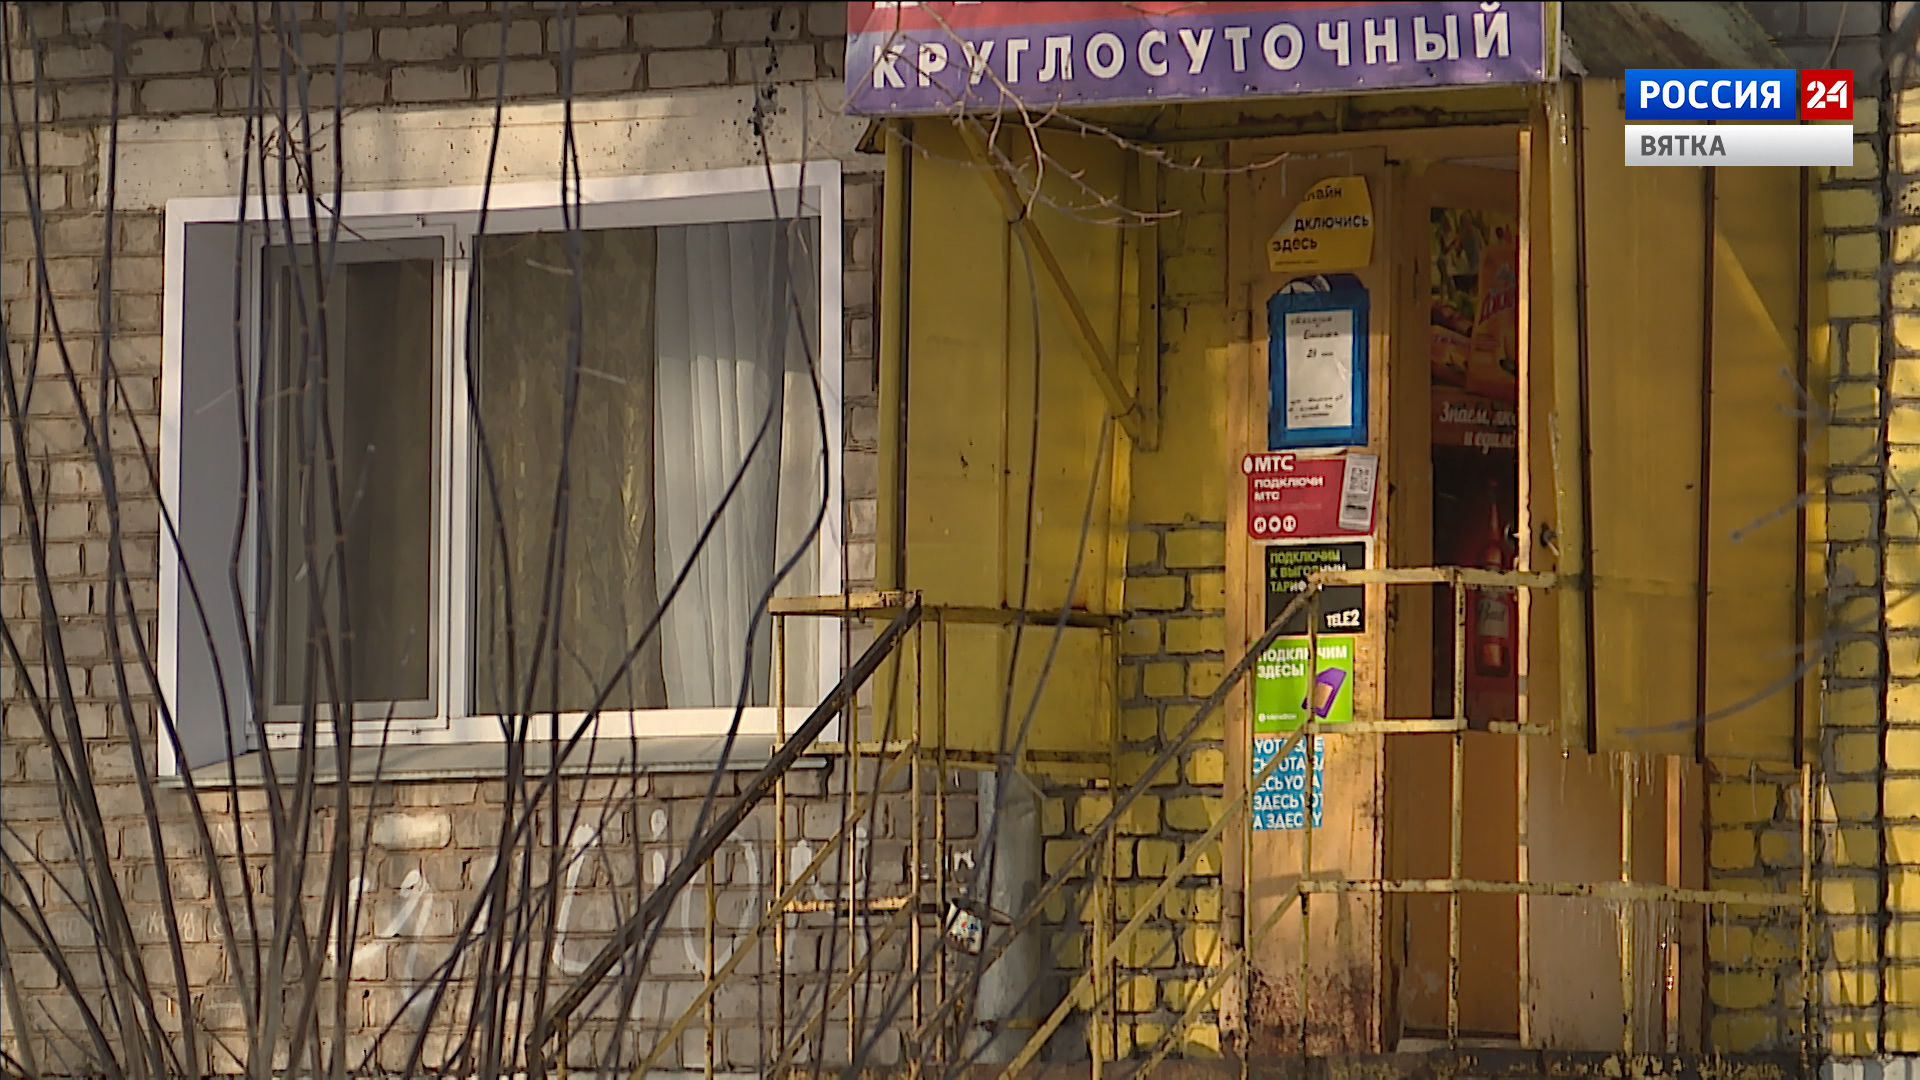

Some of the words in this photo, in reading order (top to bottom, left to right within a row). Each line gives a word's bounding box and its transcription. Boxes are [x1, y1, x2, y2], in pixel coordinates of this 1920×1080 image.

[873, 2, 1510, 89] КРУГЛОСУТОЧНЫЙ
[1255, 455, 1293, 472] МТС
[1270, 550, 1340, 564] ПОДКЛЮЧИМ
[1270, 580, 1323, 593] ТАРИФ
[1326, 609, 1360, 627] TELE2
[1257, 645, 1347, 662] ПОДКЛЧИМ
[1254, 738, 1287, 754] YOT
[1278, 757, 1306, 772] OTA
[1254, 793, 1299, 811] ЗДЕСЬ
[1267, 811, 1304, 830] ЗДЕС
